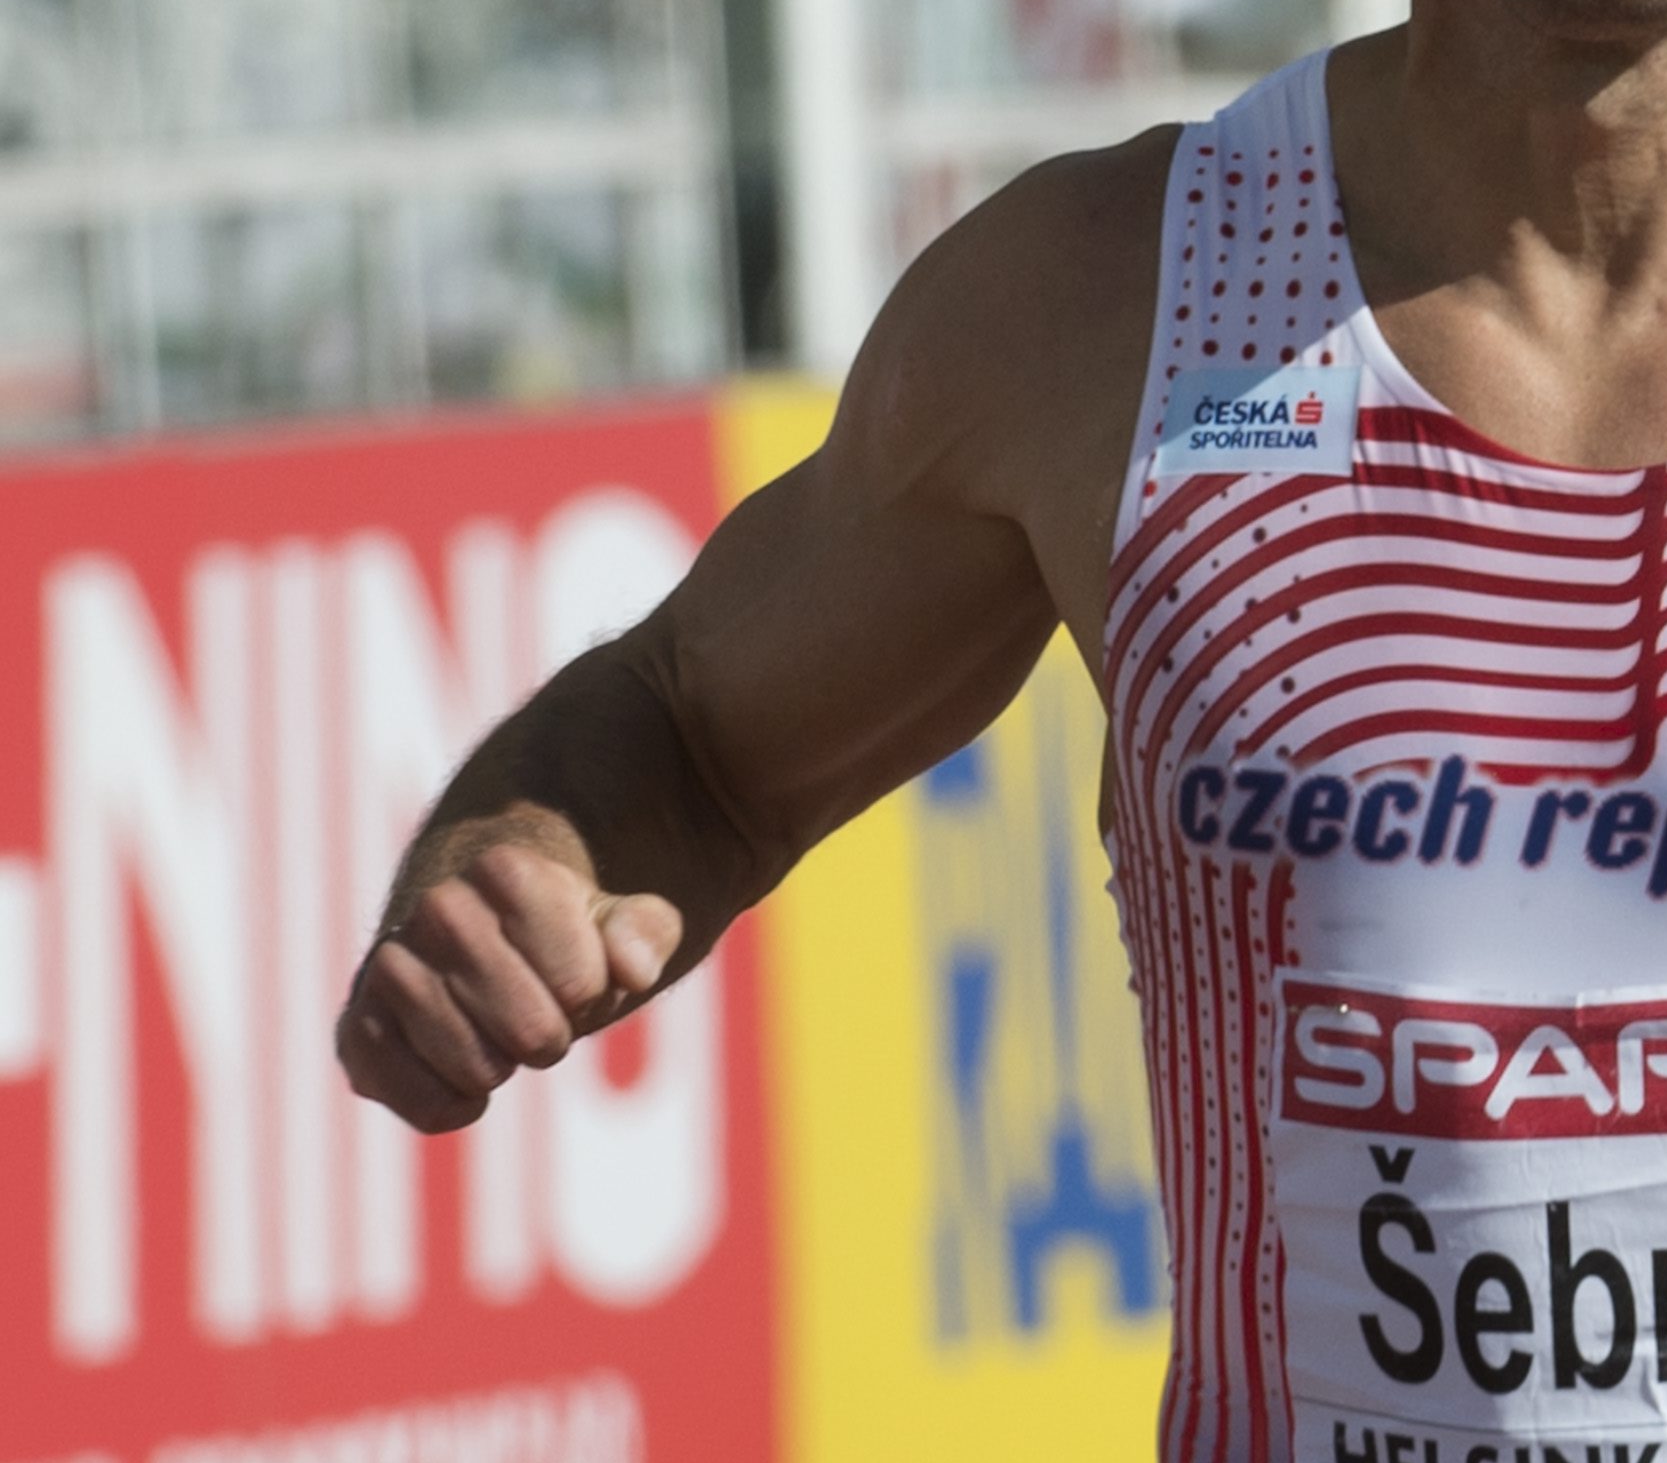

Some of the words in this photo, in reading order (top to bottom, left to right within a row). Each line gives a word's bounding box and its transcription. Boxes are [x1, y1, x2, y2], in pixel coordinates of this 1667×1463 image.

[1193, 393, 1290, 426] ČESKÁ
[1189, 427, 1318, 450] SPOŘITELNA
[1177, 754, 1496, 870] czech
